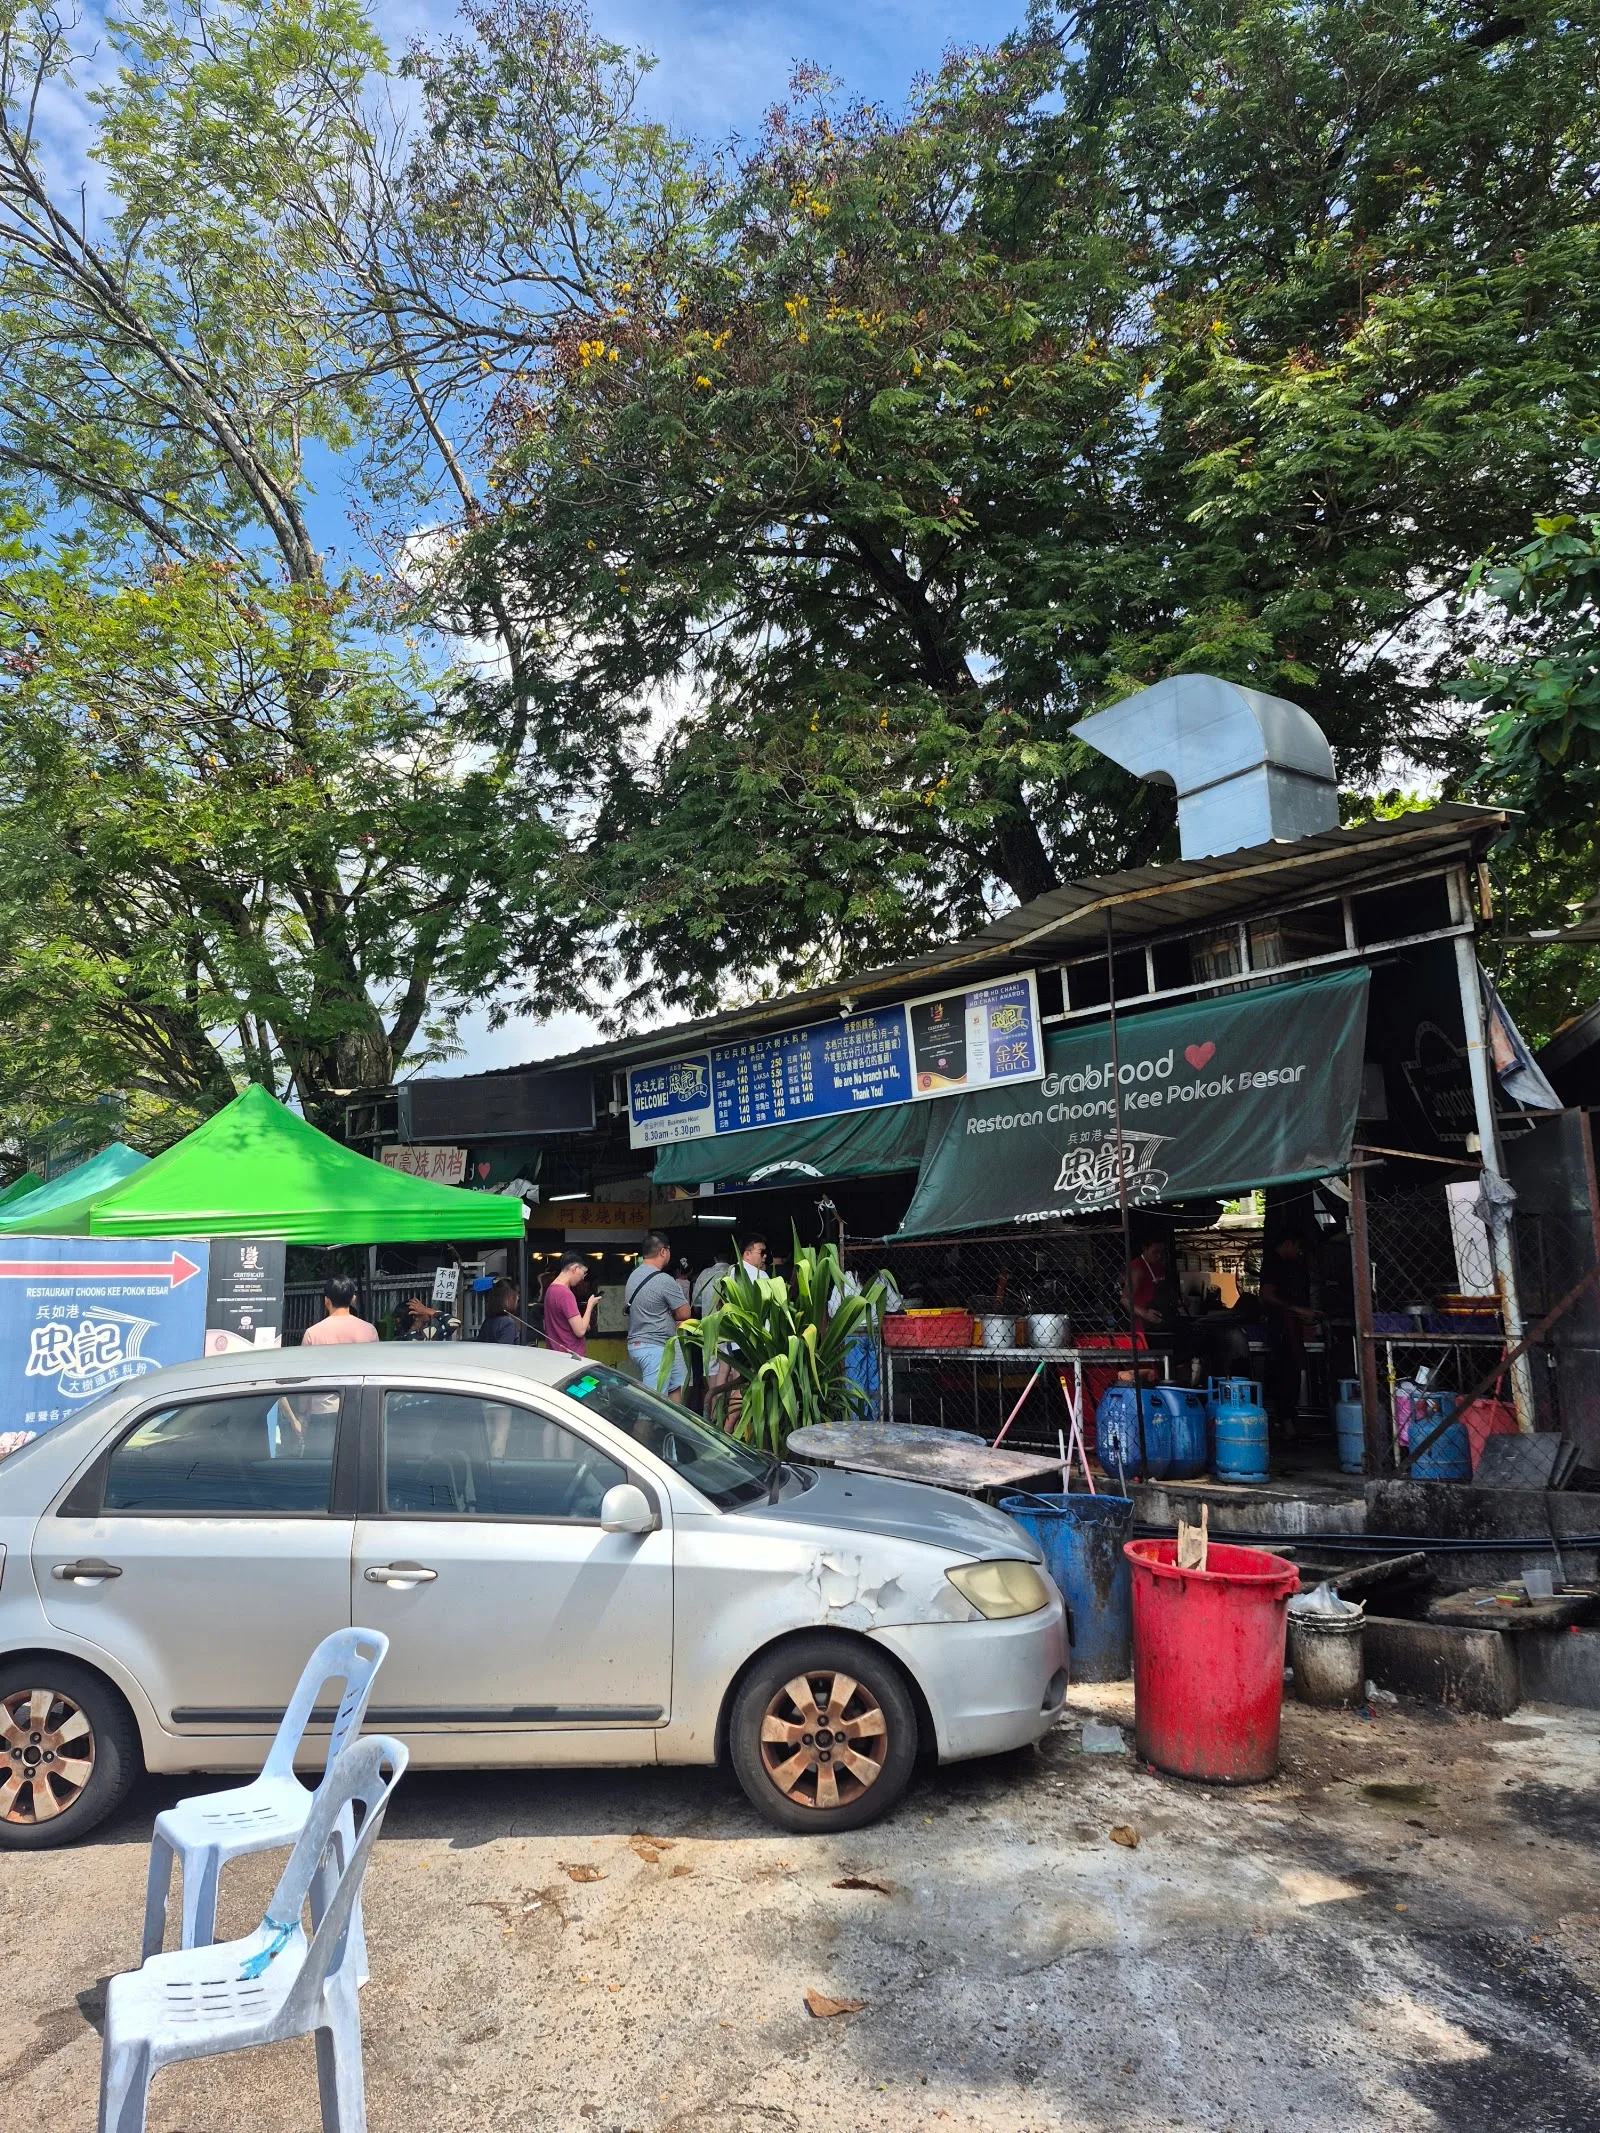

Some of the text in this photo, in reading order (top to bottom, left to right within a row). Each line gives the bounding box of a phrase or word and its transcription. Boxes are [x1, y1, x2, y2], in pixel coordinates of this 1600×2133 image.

[1000, 990, 1024, 1000] AWARDS
[996, 1041, 1029, 1063] 金奖
[996, 1060, 1030, 1073] GOLD
[1041, 1049, 1174, 1097] GrabFood
[753, 1072, 769, 1081] LAKSA
[833, 1076, 842, 1088] We
[844, 1076, 852, 1086] are
[854, 1072, 862, 1084] No
[863, 1068, 882, 1083] branch
[883, 1067, 889, 1079] in
[852, 1084, 883, 1100] Thank You!
[967, 1065, 1307, 1134] Restoran Choong Kee Pokok Besar
[635, 1092, 669, 1111] WELCOME!
[644, 1131, 668, 1141] 8.30am
[674, 1125, 701, 1136] 5.30pm
[1068, 1129, 1102, 1145] 兵如港
[1054, 1142, 1135, 1191] 忠記
[26, 1286, 169, 1297] RESTAURANT CHOONG KEE POKOK BESAR
[36, 1304, 79, 1319] 兵如港
[25, 1320, 124, 1377] 忠記
[69, 1362, 147, 1391] 大樹頭炸料粉
[25, 1409, 82, 1423] 經營各式
